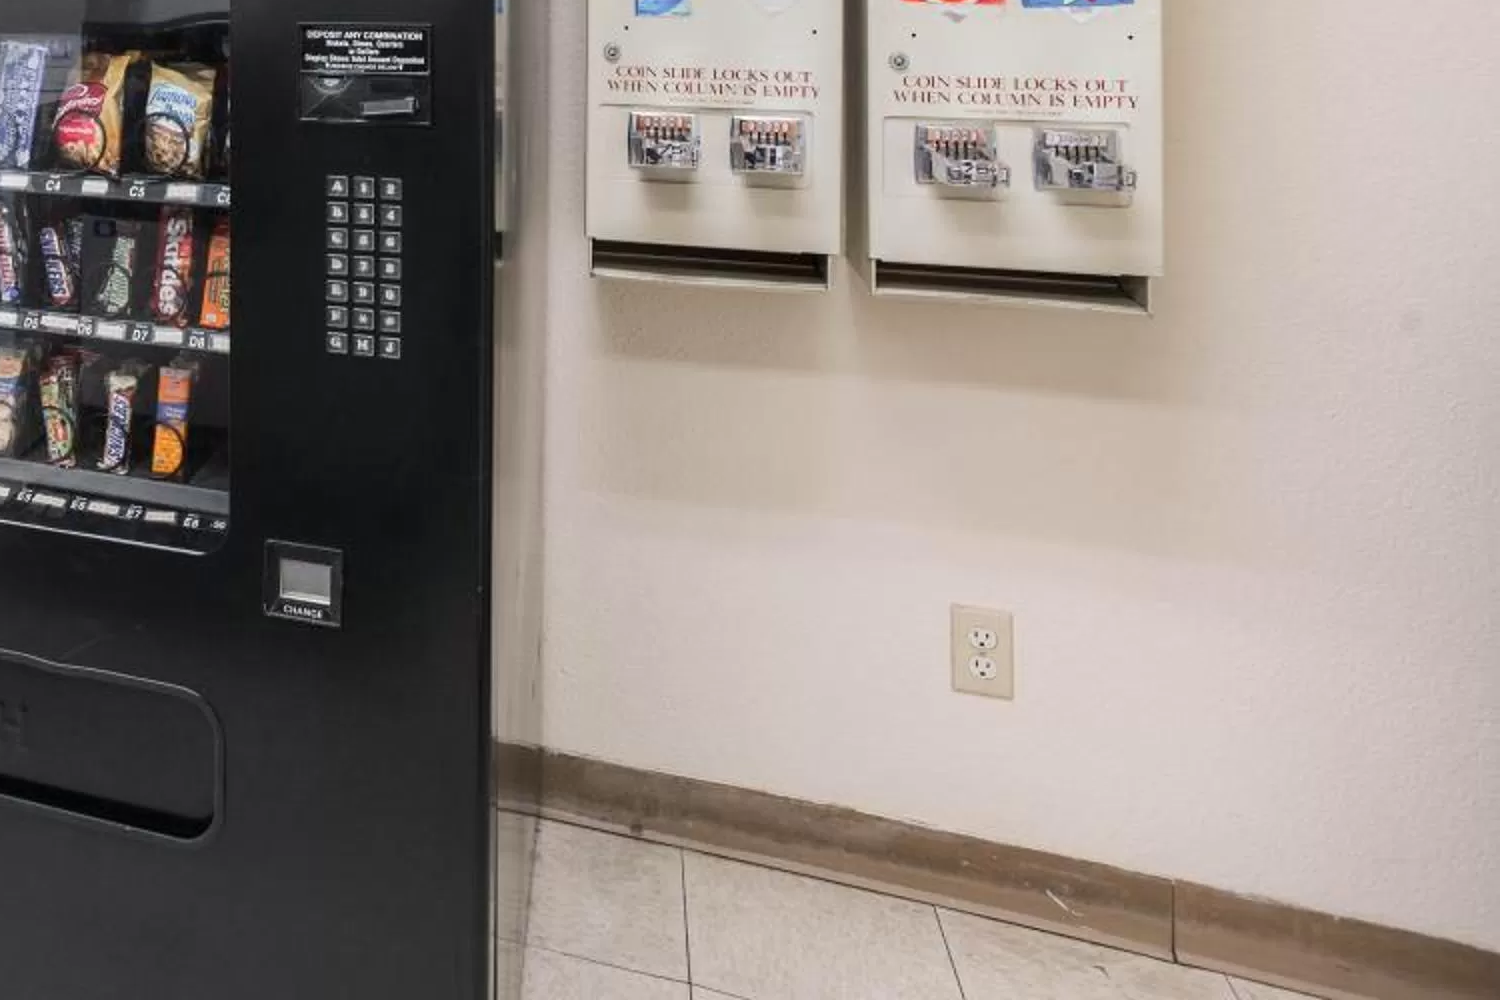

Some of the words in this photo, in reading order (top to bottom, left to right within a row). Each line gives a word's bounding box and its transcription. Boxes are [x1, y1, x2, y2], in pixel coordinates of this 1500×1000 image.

[615, 66, 656, 79] COIN
[663, 67, 706, 80] SLIDE
[713, 68, 769, 82] LOCKS
[775, 71, 813, 83] OUT
[903, 75, 950, 89] COIN
[956, 75, 1004, 90] SLIDE
[1014, 77, 1079, 91] LOCKS
[1085, 79, 1129, 92] OUT
[607, 80, 658, 93] WHEN
[663, 81, 738, 96] COLUMN
[743, 84, 757, 97] IS
[763, 85, 820, 100] EMPTY
[893, 90, 951, 104] WHEN
[957, 91, 1041, 106] COLUMN
[1049, 93, 1065, 107] IS
[1073, 95, 1139, 110] EMPTY
[159, 216, 188, 316] Skittles
[132, 329, 149, 342] D7
